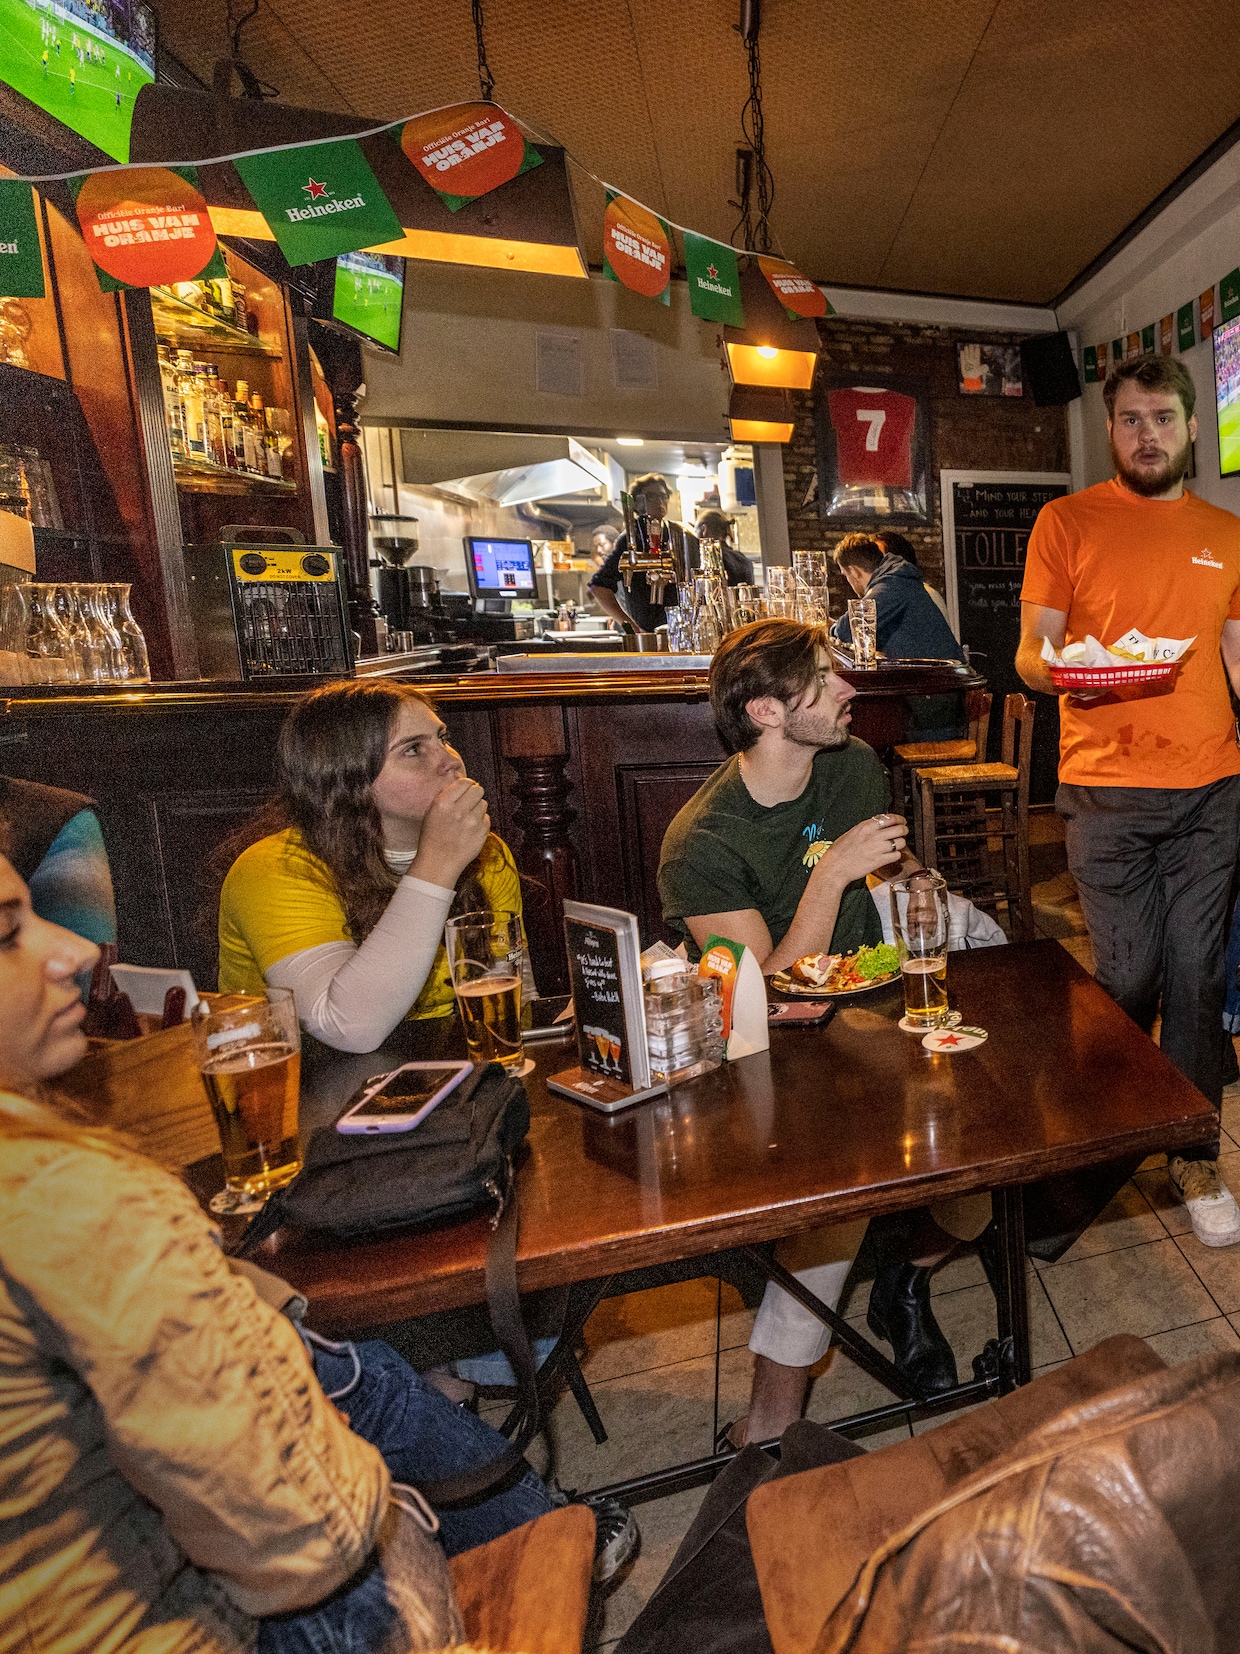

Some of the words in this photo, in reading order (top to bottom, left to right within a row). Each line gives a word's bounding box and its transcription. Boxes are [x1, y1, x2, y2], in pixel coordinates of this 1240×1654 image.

[422, 140, 466, 167] HUIS
[464, 120, 506, 144] VAN
[452, 125, 475, 138] Oranje
[436, 130, 506, 172] ORANJE
[134, 206, 164, 217] Oranje
[166, 204, 186, 213] Bar!
[285, 194, 366, 222] Heineken
[92, 218, 146, 237] HUIS
[147, 214, 200, 231] VAN
[103, 226, 196, 248] ORANJE
[611, 228, 640, 250] HUIS
[641, 244, 666, 264] VAN
[615, 240, 662, 271] ORANJE
[696, 277, 732, 297] Heineken
[856, 410, 886, 452] 7
[1020, 509, 1038, 518] HEA
[956, 532, 1027, 566] TOILE
[1191, 556, 1223, 570] Heineken
